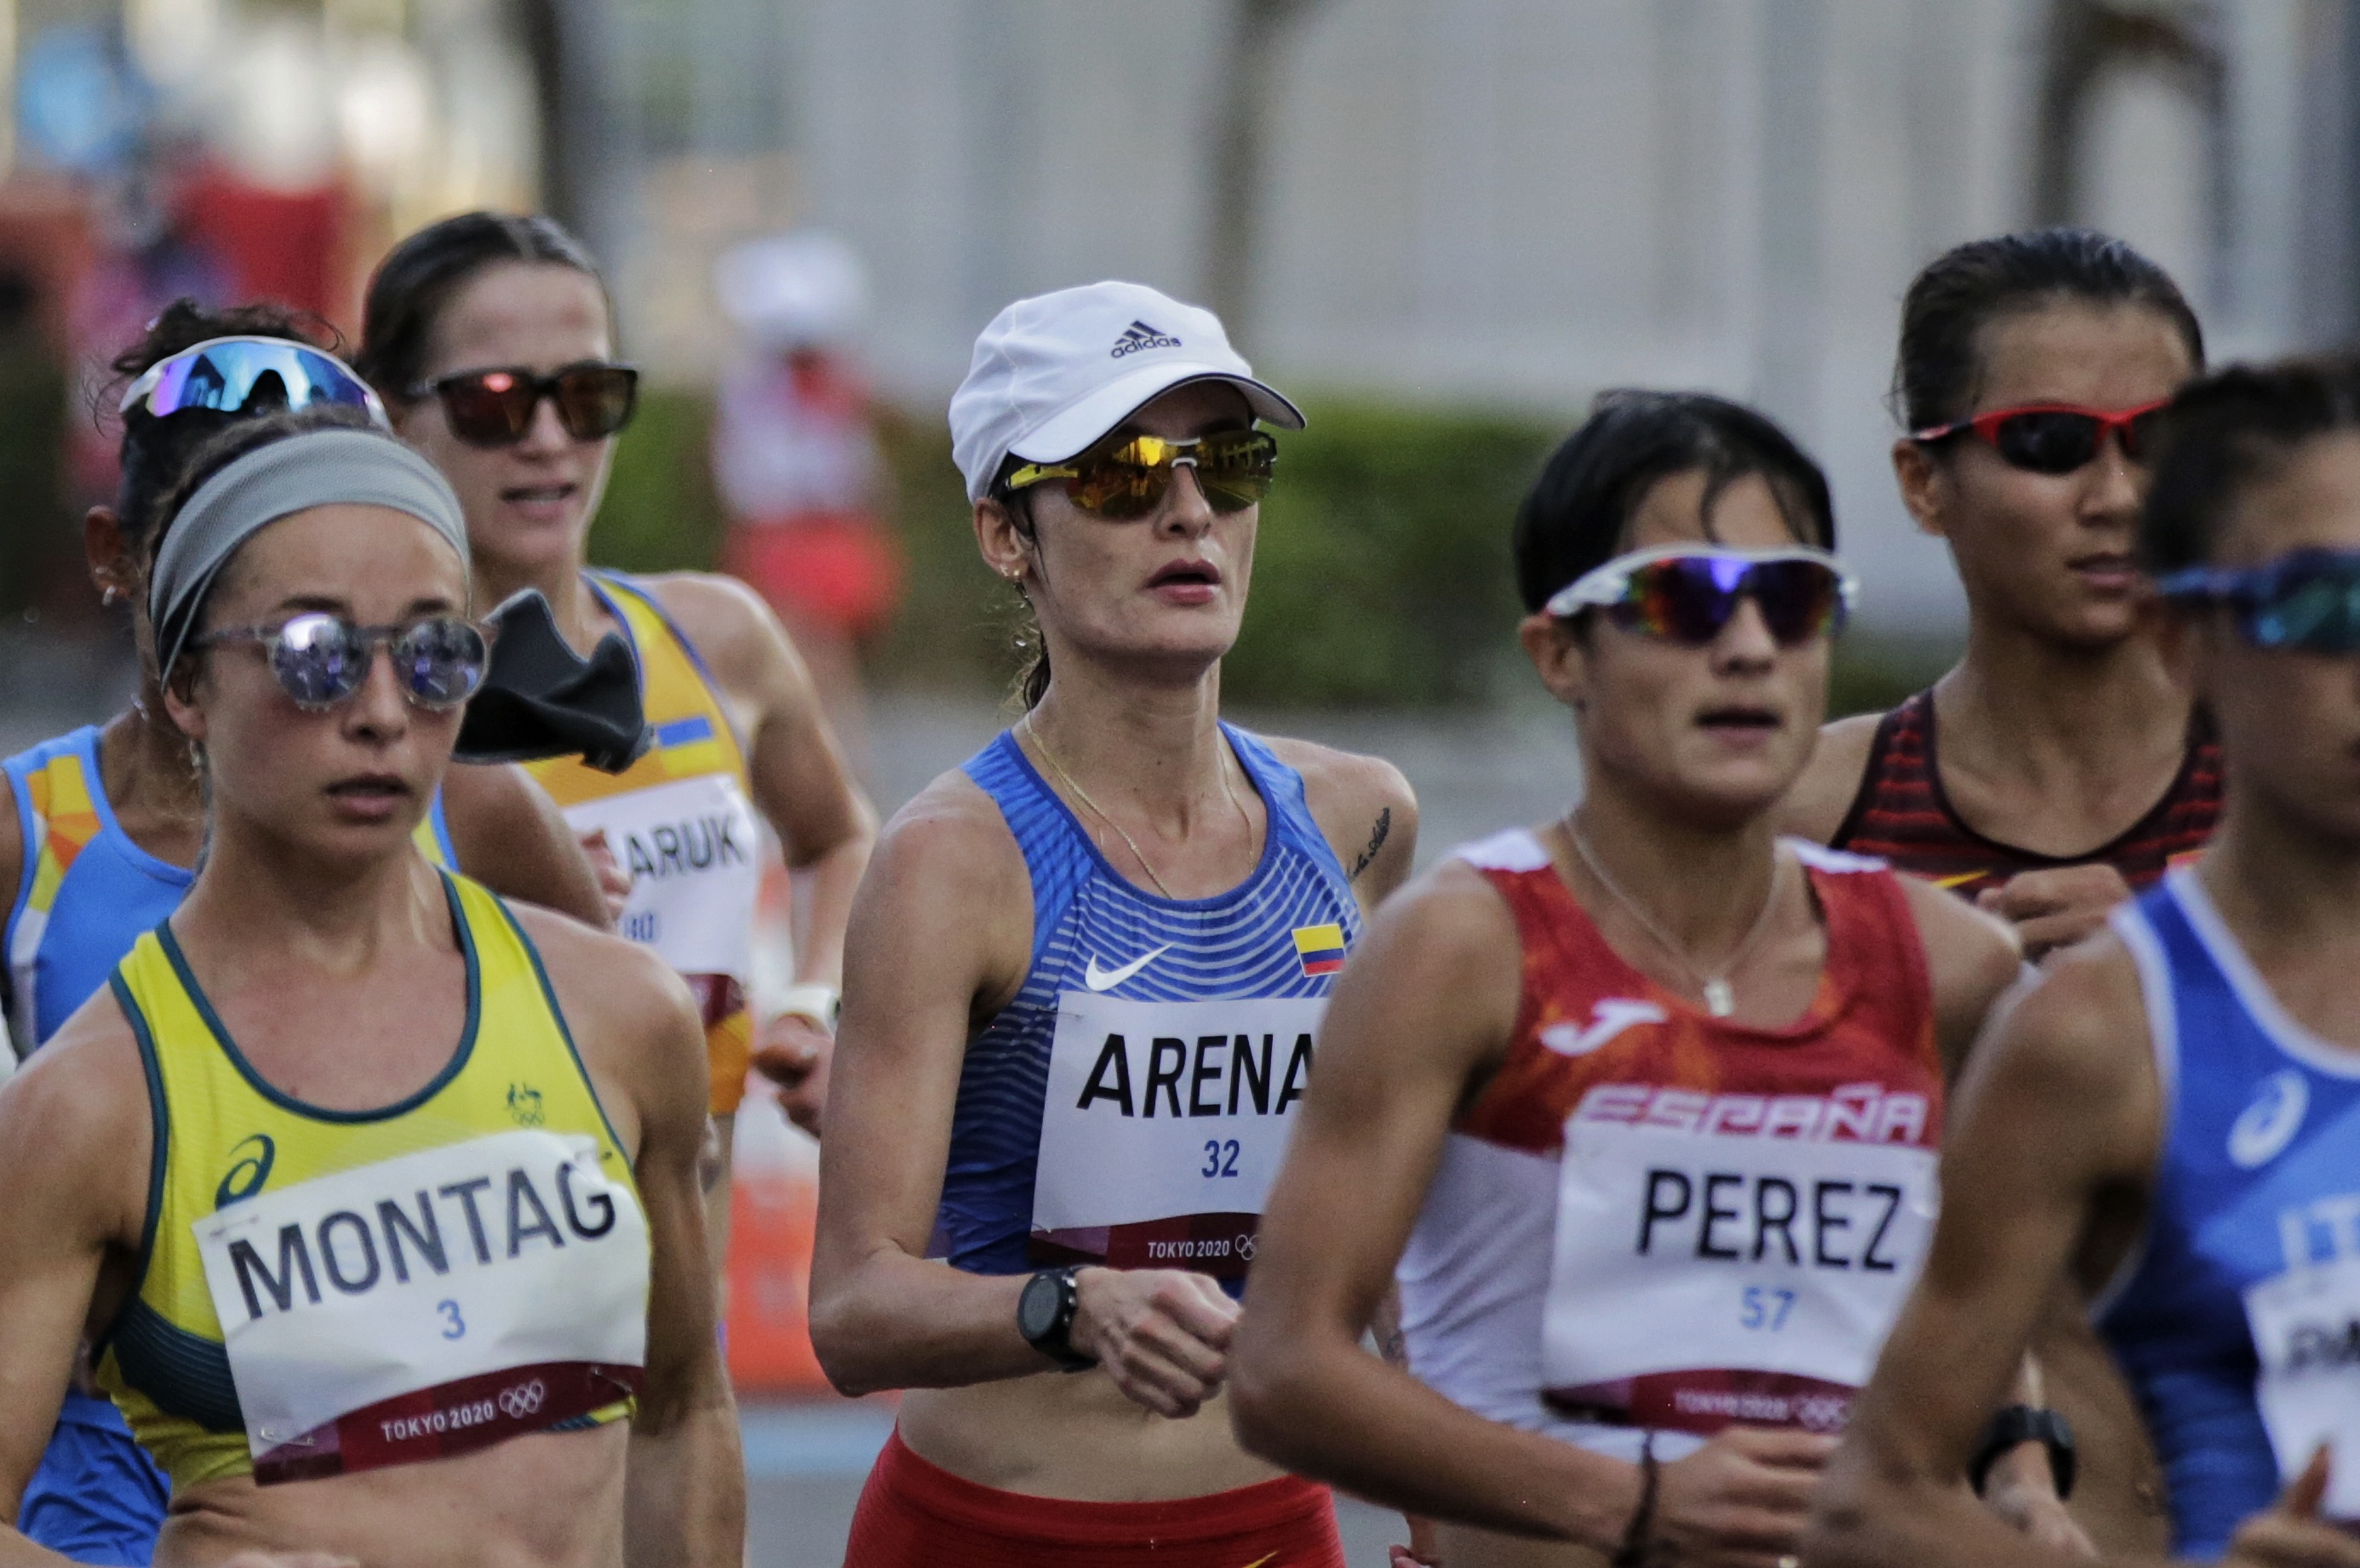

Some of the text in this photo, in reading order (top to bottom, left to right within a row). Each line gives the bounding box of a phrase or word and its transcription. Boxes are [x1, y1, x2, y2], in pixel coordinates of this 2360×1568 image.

[1111, 336, 1182, 358] adidas
[1201, 1139, 1240, 1178] 32
[228, 1160, 616, 1320] MONTAG
[1636, 1169, 1902, 1271] PEREZ
[1148, 1239, 1230, 1259] TOKYO 2020
[437, 1299, 466, 1341] 3
[1739, 1285, 1796, 1332] 57
[380, 1401, 494, 1444] TOKYO 2020
